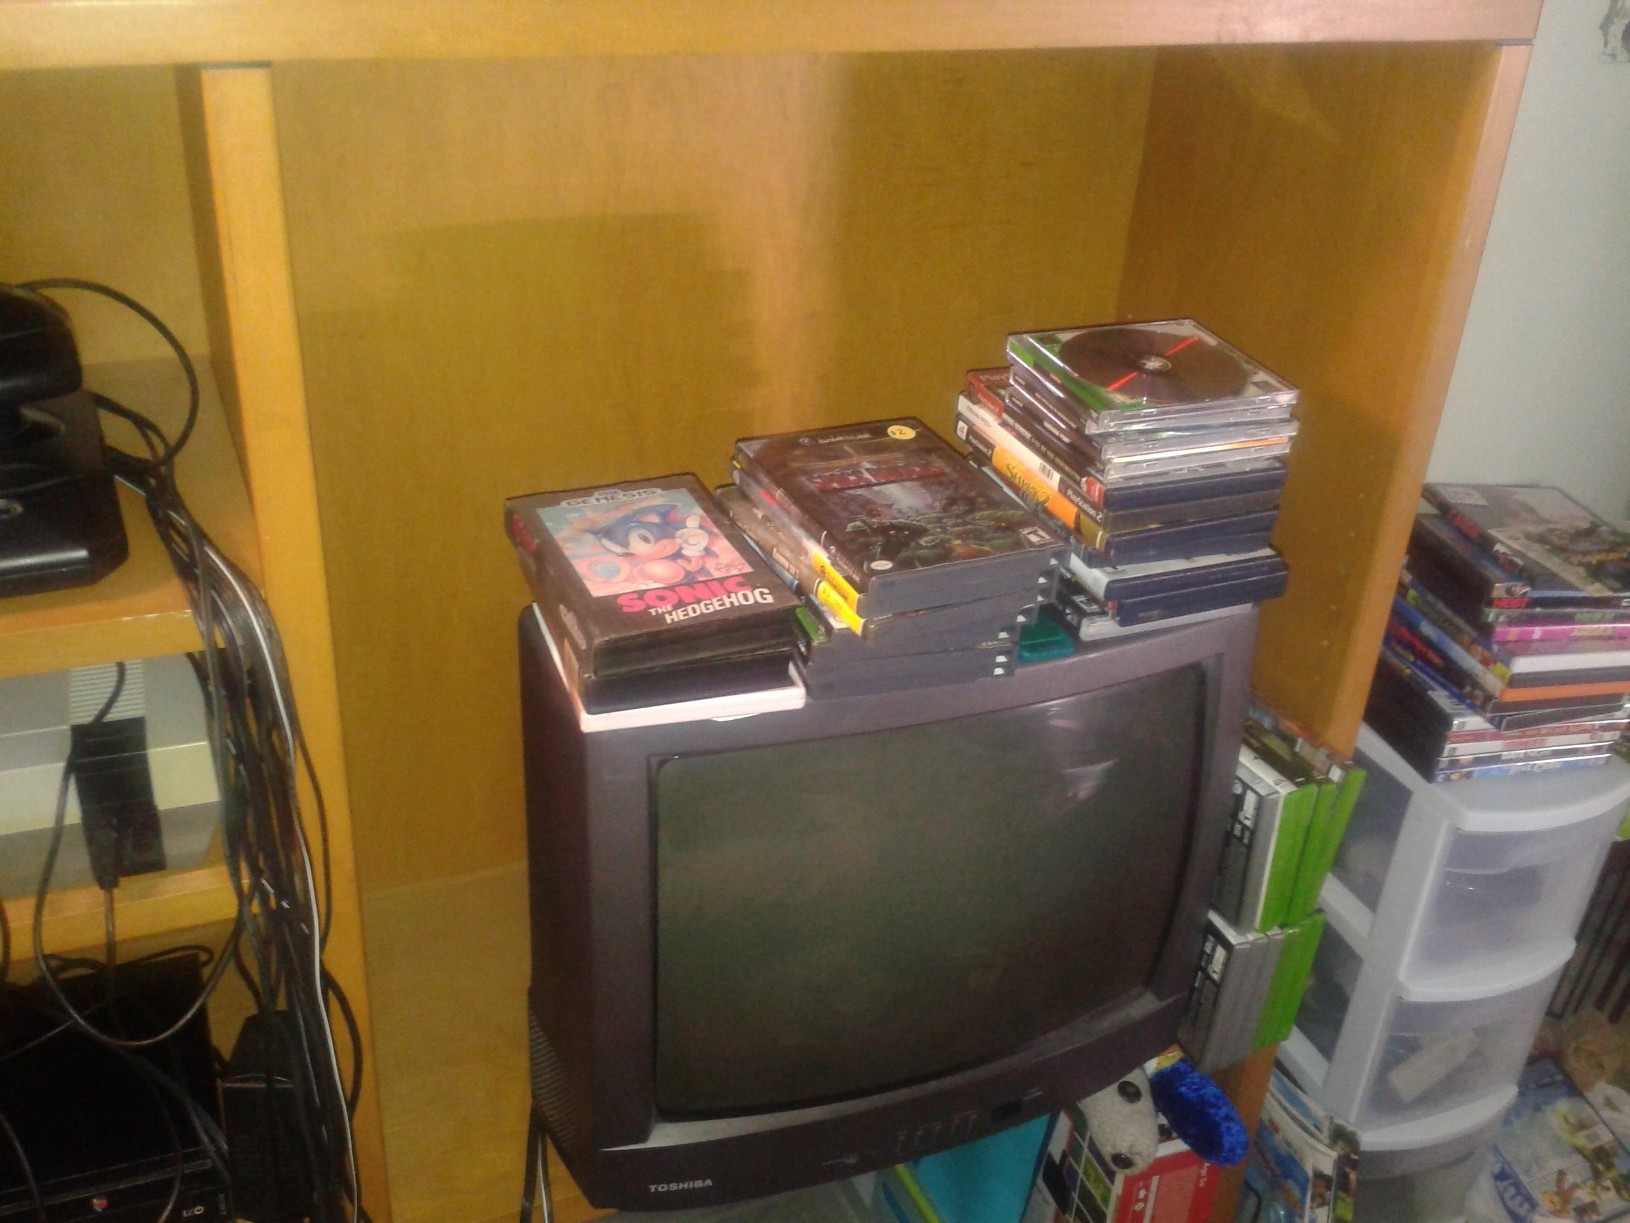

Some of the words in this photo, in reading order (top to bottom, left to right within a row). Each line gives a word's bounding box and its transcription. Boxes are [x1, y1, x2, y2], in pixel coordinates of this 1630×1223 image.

[566, 489, 657, 506] GENESIS
[616, 576, 752, 613] SONIC
[648, 604, 674, 616] THE
[664, 587, 775, 624] HEDGEHOG
[648, 1178, 713, 1193] TOSHIBA
